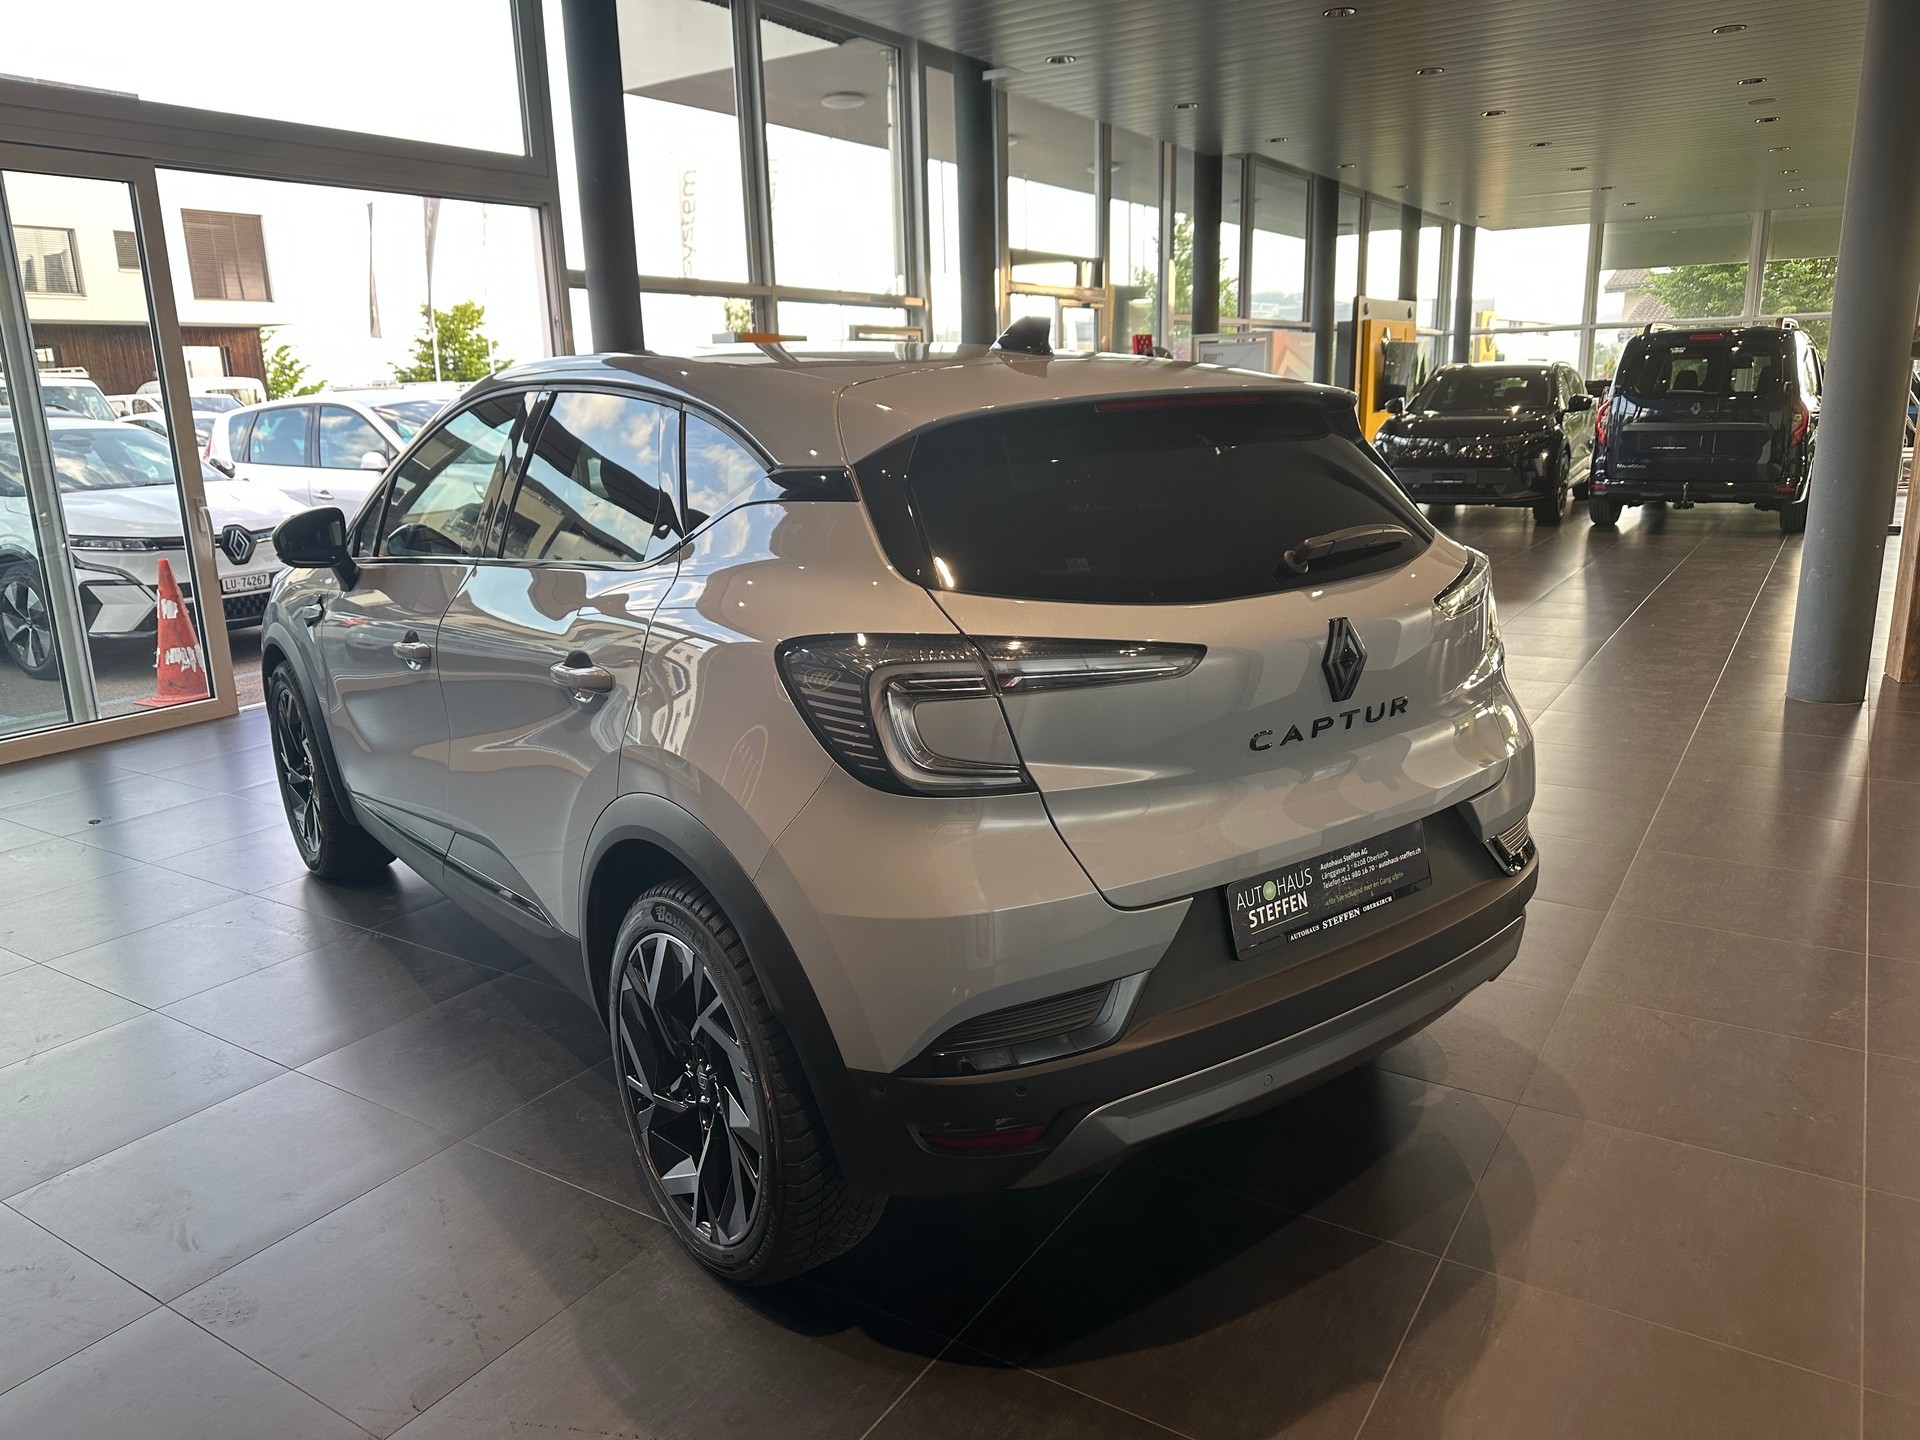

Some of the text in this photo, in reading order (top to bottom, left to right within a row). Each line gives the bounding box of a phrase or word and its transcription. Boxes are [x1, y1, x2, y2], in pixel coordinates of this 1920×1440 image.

[1249, 695, 1409, 751] CAPTUR
[1320, 847, 1368, 870] Autohaus Steffen AG
[1322, 877, 1341, 889] Telefon
[1340, 874, 1351, 883] 041
[1368, 864, 1375, 873] 70
[1378, 847, 1422, 869] autohaus-steffen.ch
[1353, 858, 1367, 869] 6208
[1366, 850, 1389, 863] Oberkirch
[1236, 867, 1313, 911] AUTOHAUS
[1248, 890, 1308, 928] STEFFEN
[1290, 895, 1393, 941] AUTOHAUS STEFFEN OBERKIRCH
